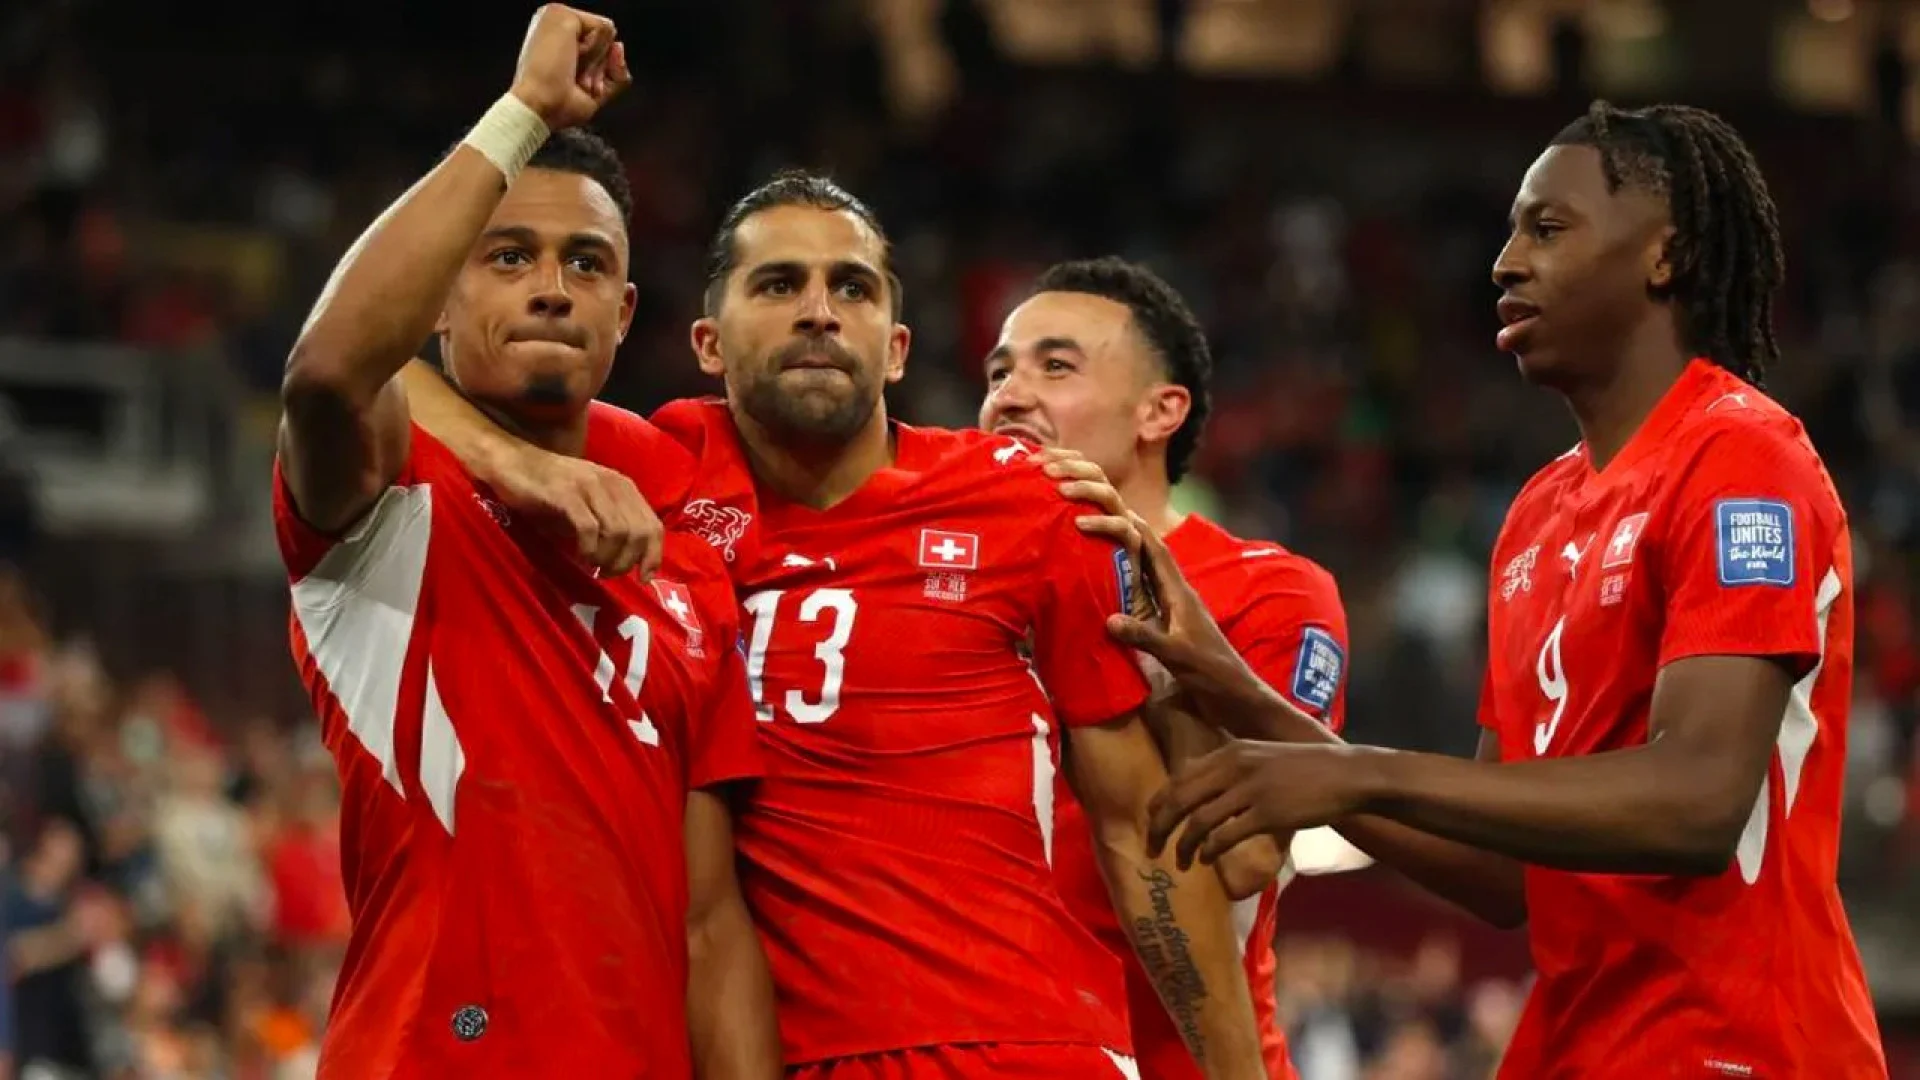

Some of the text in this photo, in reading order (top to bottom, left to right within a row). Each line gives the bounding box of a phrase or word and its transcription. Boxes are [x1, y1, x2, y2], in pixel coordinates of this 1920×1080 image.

[1730, 512, 1780, 526] FOOTBALL
[1730, 526, 1782, 544] UNITES
[743, 588, 859, 723] 13
[1533, 613, 1568, 756] 9
